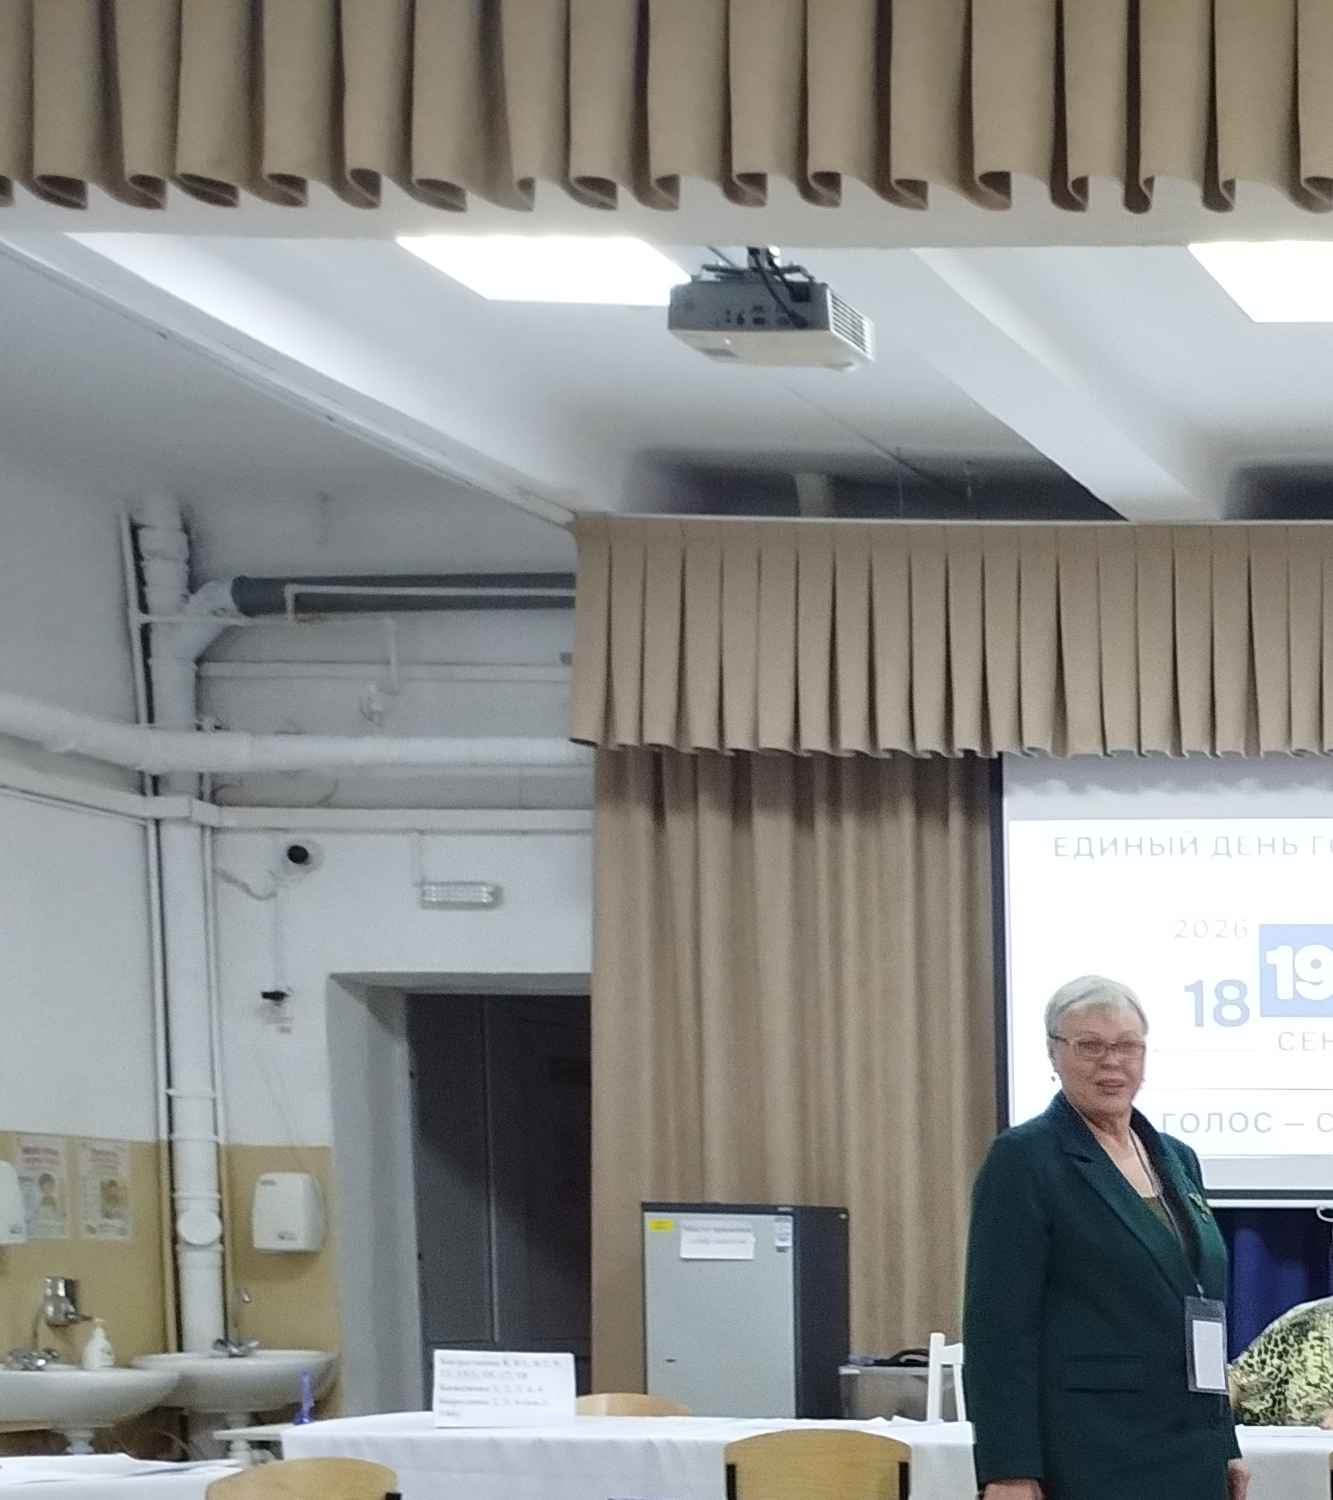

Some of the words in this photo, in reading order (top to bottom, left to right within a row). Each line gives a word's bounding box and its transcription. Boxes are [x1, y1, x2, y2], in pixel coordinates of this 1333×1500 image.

[1054, 829, 1199, 860] ЕДИНЫЙ
[1211, 836, 1299, 859] ДЕНЬ
[1173, 918, 1248, 939] 2026
[1184, 979, 1250, 1028] 18
[1162, 1112, 1273, 1133] ГОЛОС
